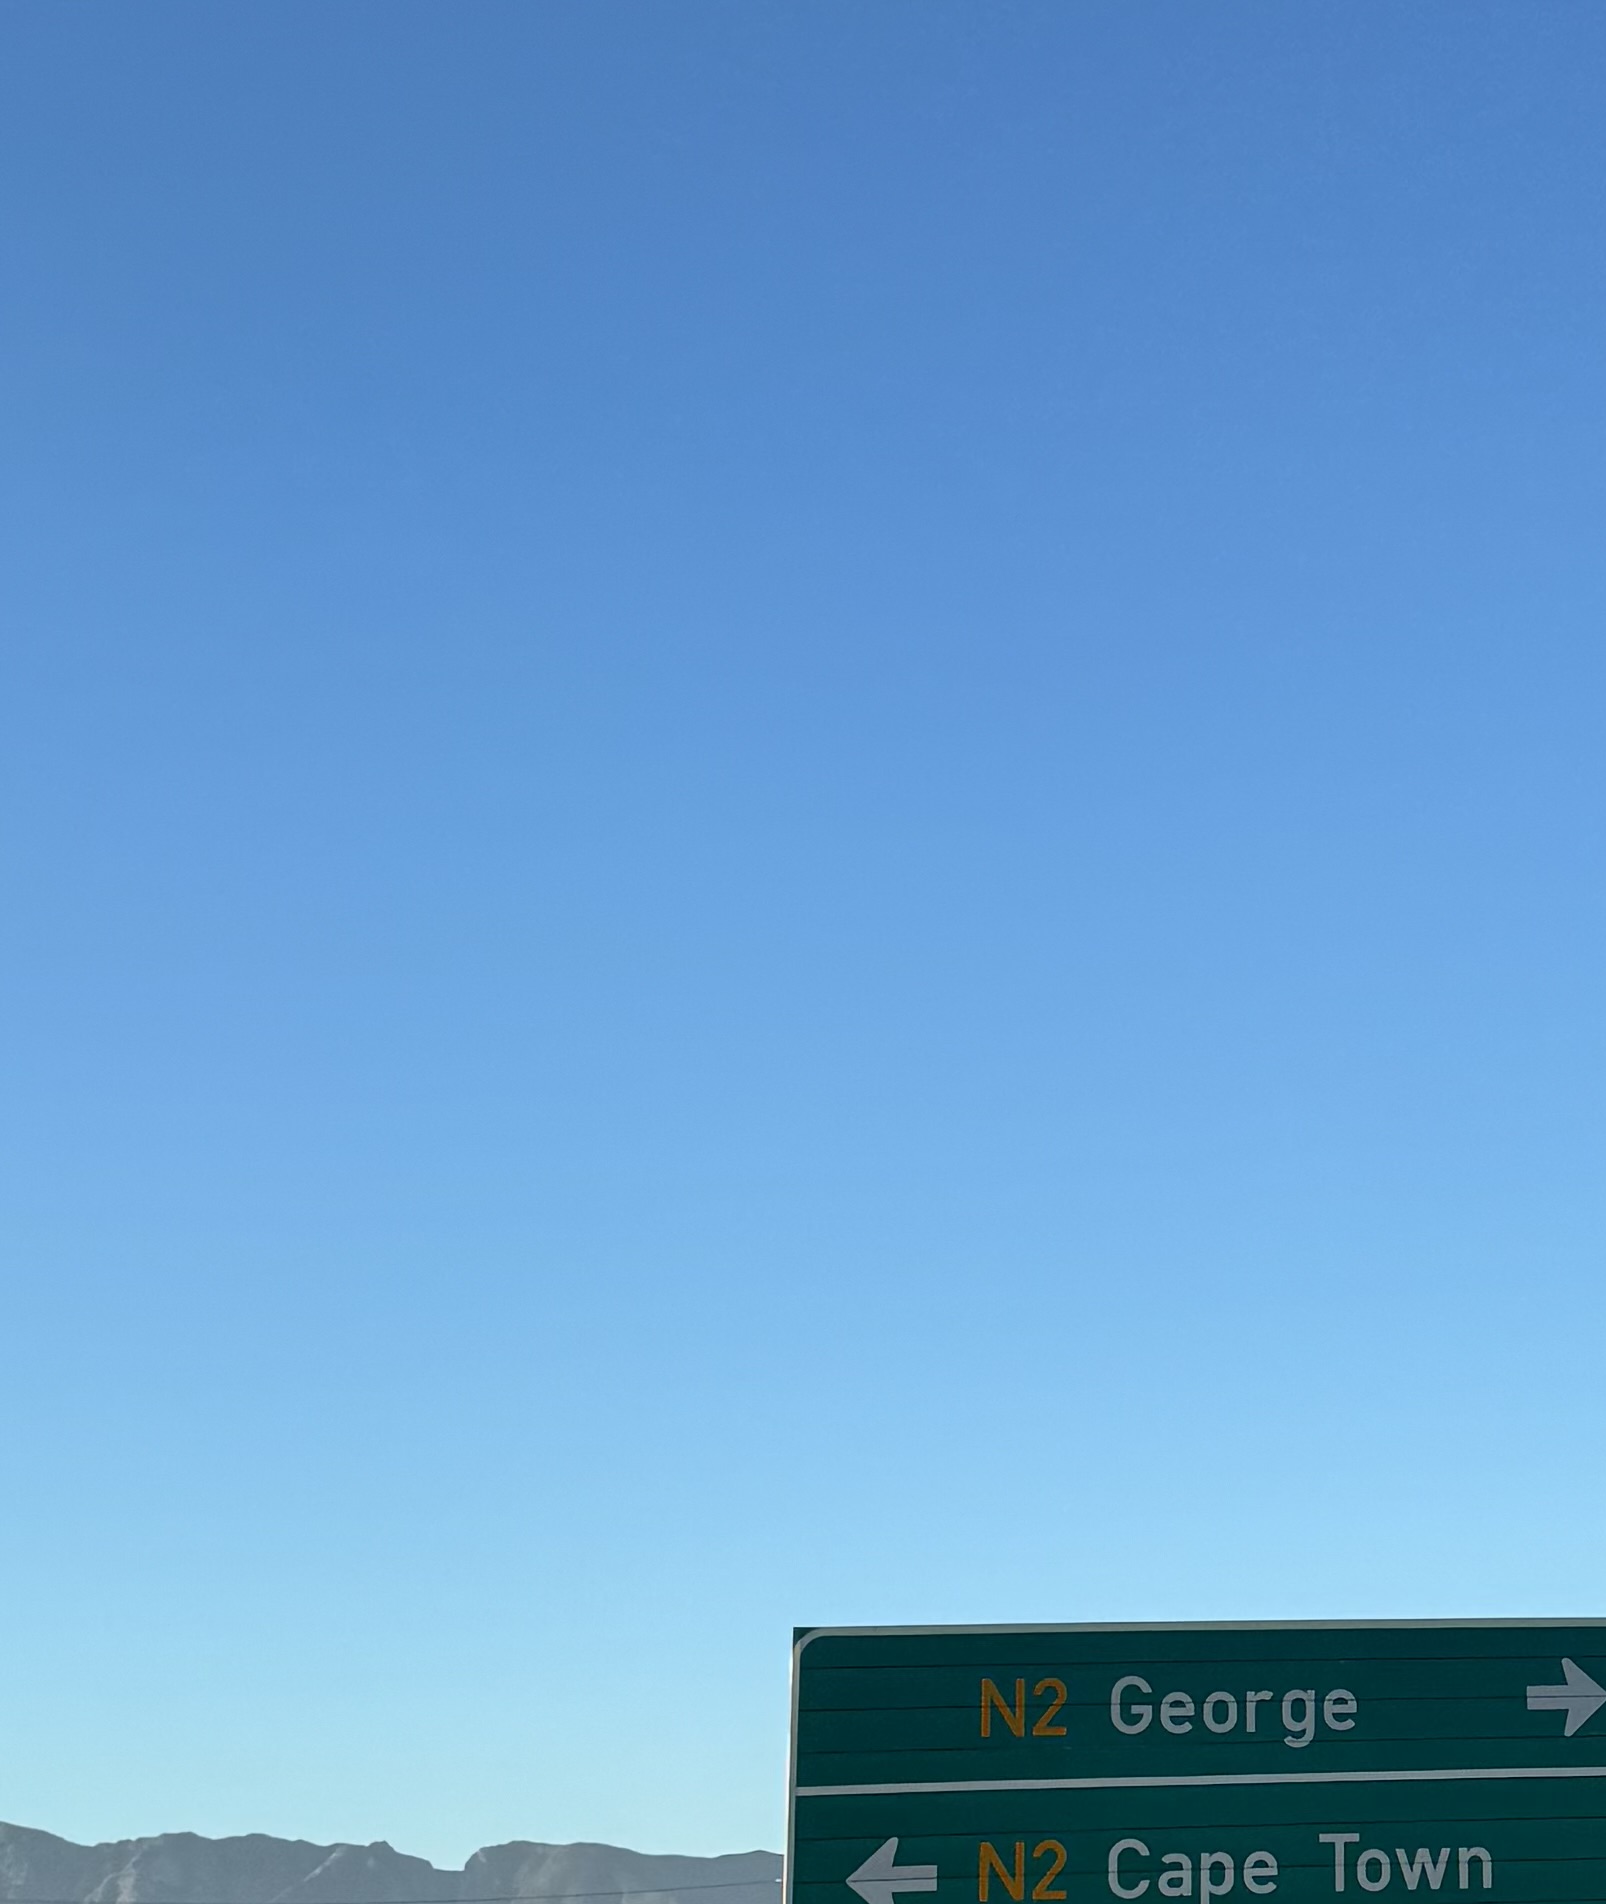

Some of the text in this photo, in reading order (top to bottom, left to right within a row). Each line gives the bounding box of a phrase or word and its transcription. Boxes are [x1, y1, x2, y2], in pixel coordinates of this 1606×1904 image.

[979, 1675, 1358, 1748] N2 George
[978, 1840, 1067, 1902] N2
[1318, 1833, 1493, 1893] Town
